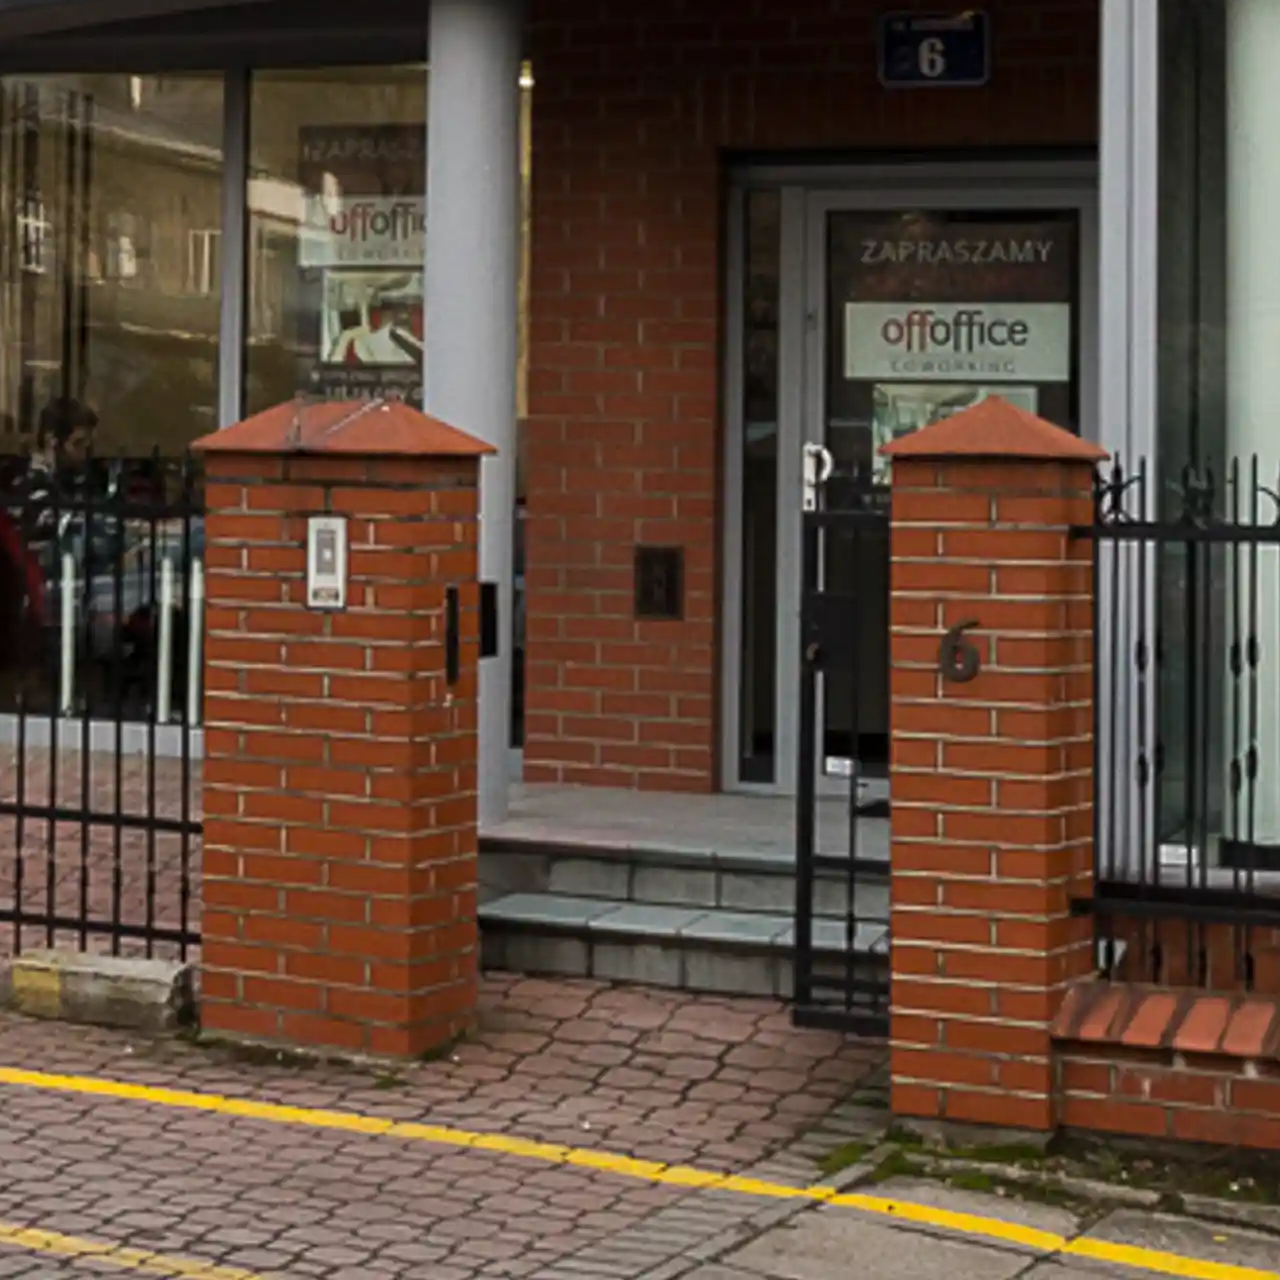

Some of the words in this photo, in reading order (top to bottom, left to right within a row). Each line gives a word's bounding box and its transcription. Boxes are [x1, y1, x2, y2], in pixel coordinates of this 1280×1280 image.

[917, 36, 946, 78] 6
[860, 239, 1057, 264] ZAPRASZAMY
[881, 309, 1030, 354] offoffice
[938, 617, 981, 683] 6
